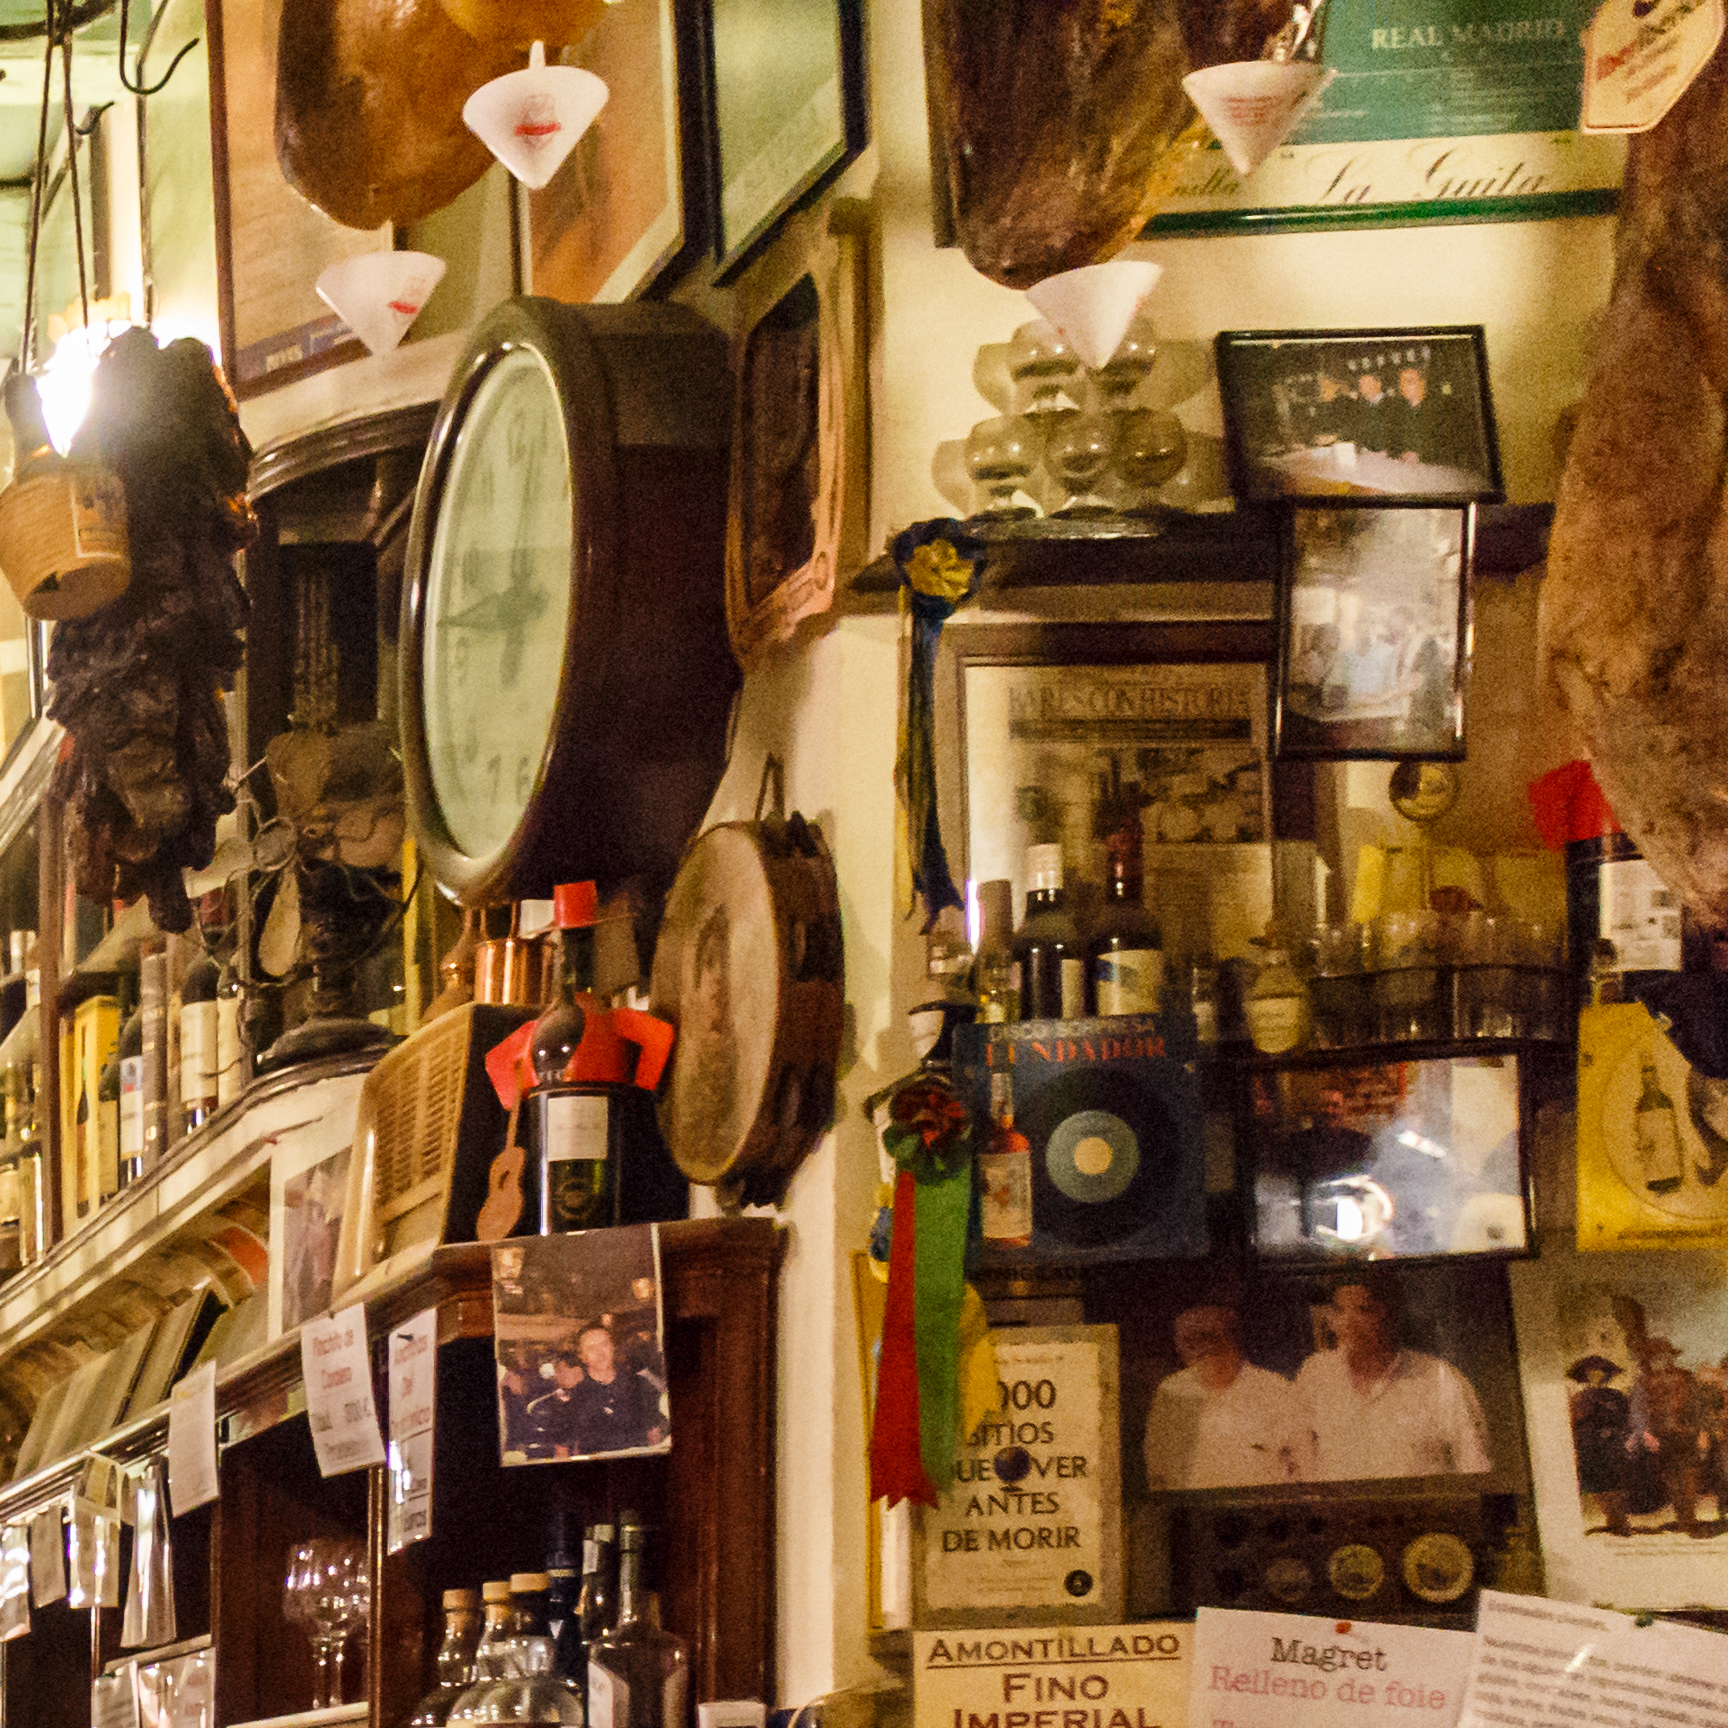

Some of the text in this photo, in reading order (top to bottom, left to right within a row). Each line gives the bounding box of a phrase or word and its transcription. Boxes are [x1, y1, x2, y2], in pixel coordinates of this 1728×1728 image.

[1371, 26, 1443, 51] REAL
[952, 1456, 1088, 1482] UE VER
[966, 1492, 1061, 1517] ANTES
[942, 1526, 1083, 1553] DE MORIR
[928, 1633, 1181, 1664] AMONTILLADO
[1269, 1636, 1388, 1674] Magret
[1002, 1672, 1110, 1703] FINO
[1207, 1665, 1447, 1711] Relleno de foie
